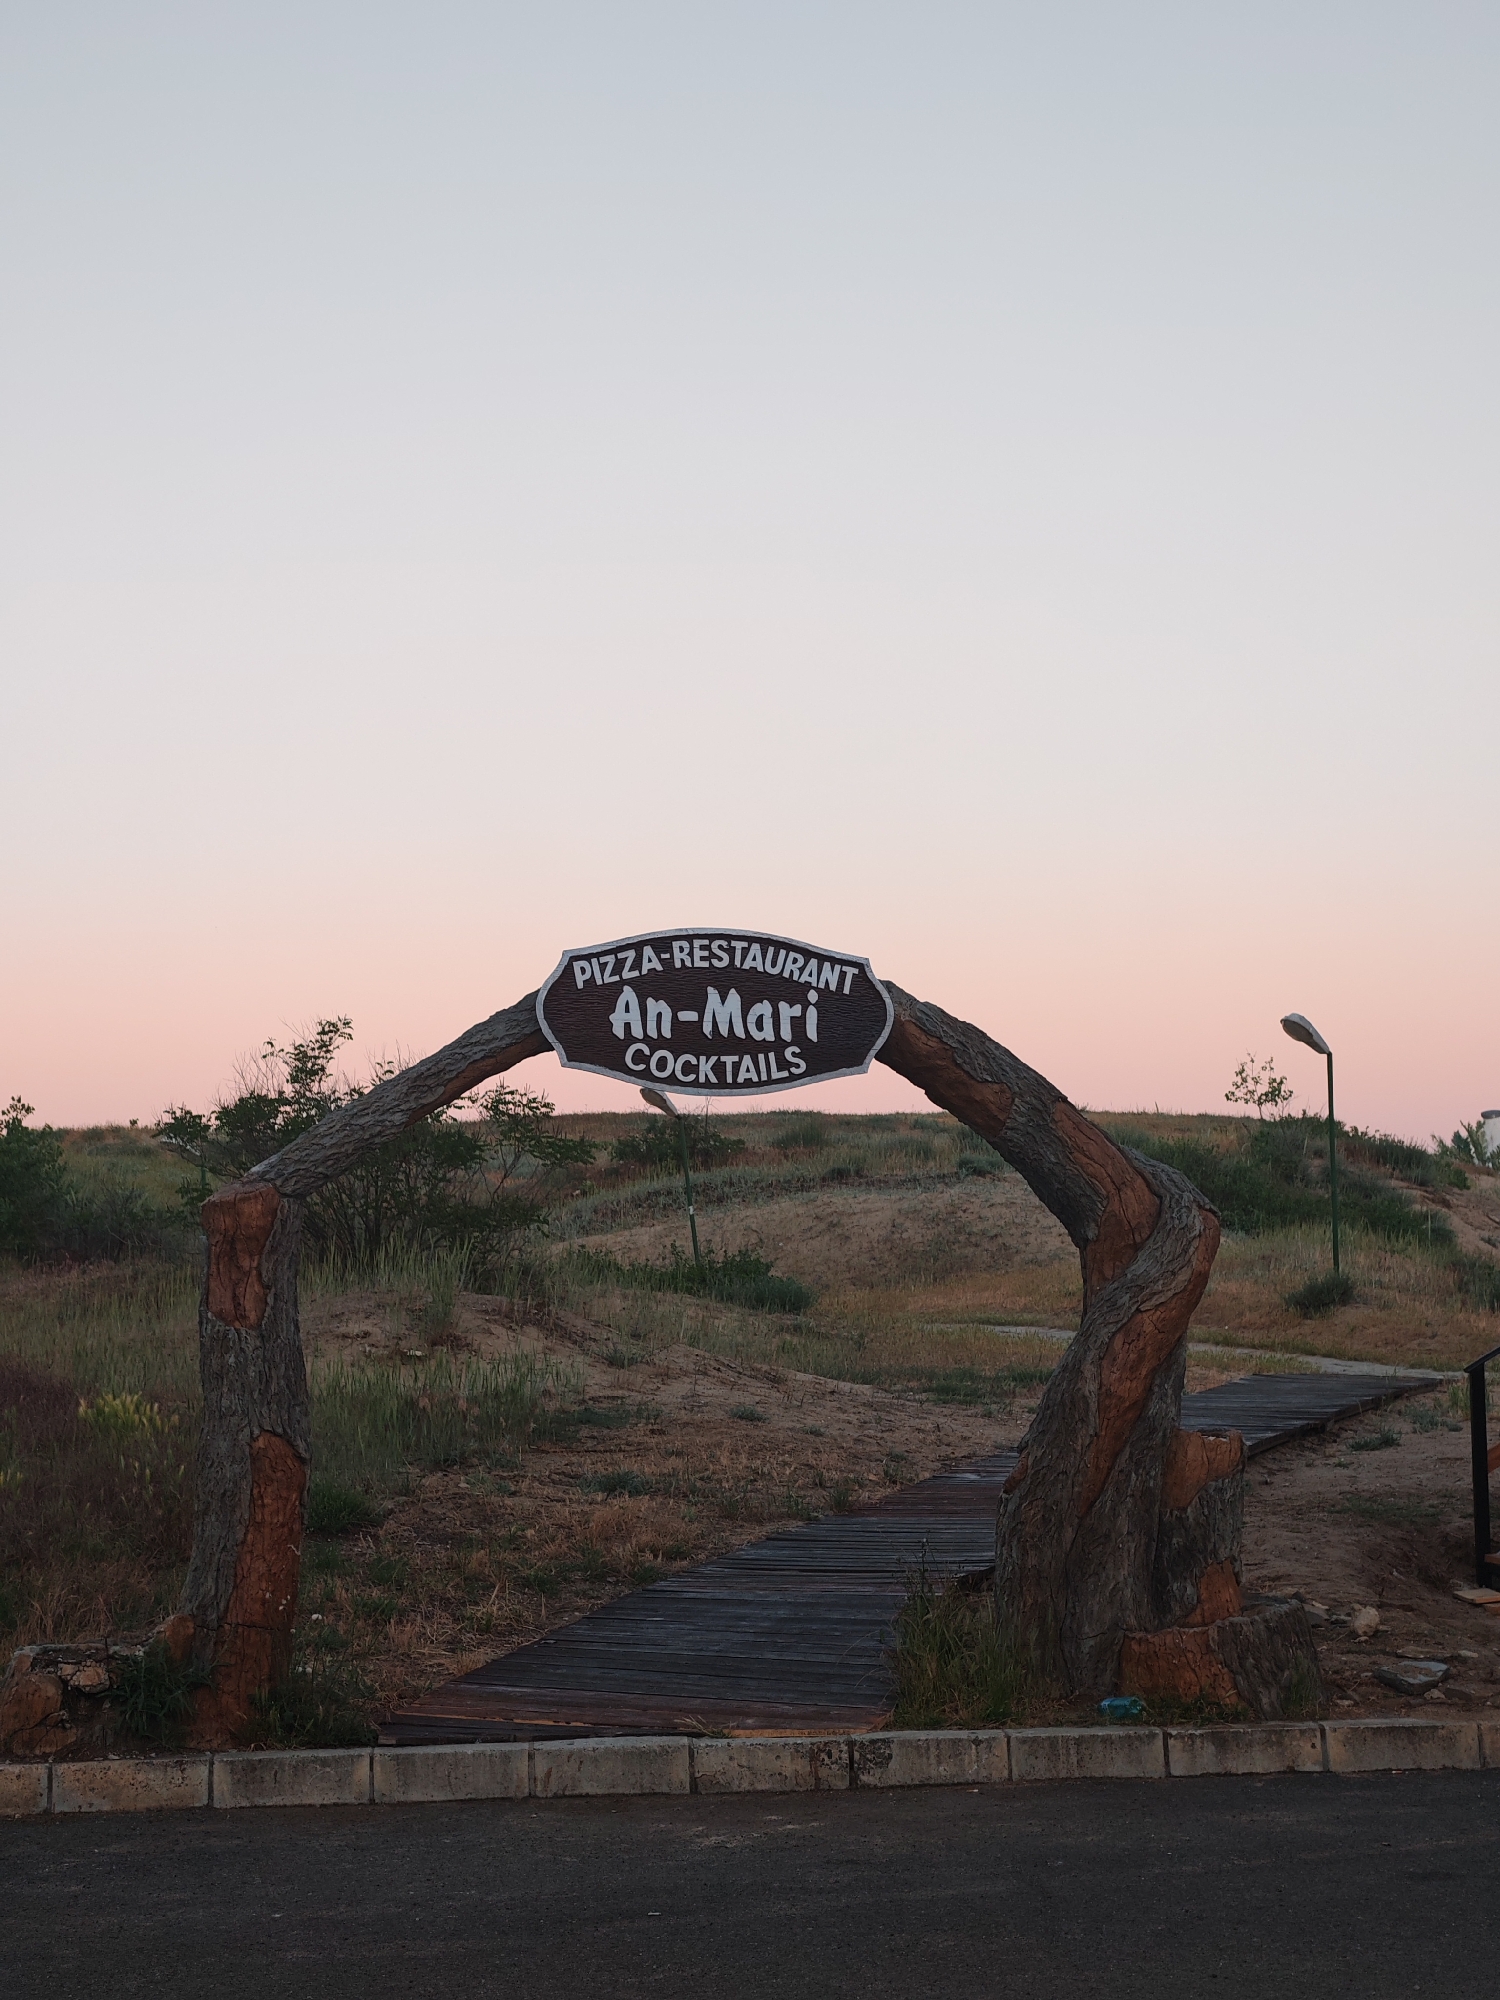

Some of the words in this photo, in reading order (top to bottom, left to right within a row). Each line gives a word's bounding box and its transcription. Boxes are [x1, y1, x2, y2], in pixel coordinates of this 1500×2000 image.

[572, 939, 859, 994] PIZZA-RESTAURANT
[609, 985, 818, 1043] An-Mari
[624, 1042, 807, 1084] COCKTAILS
